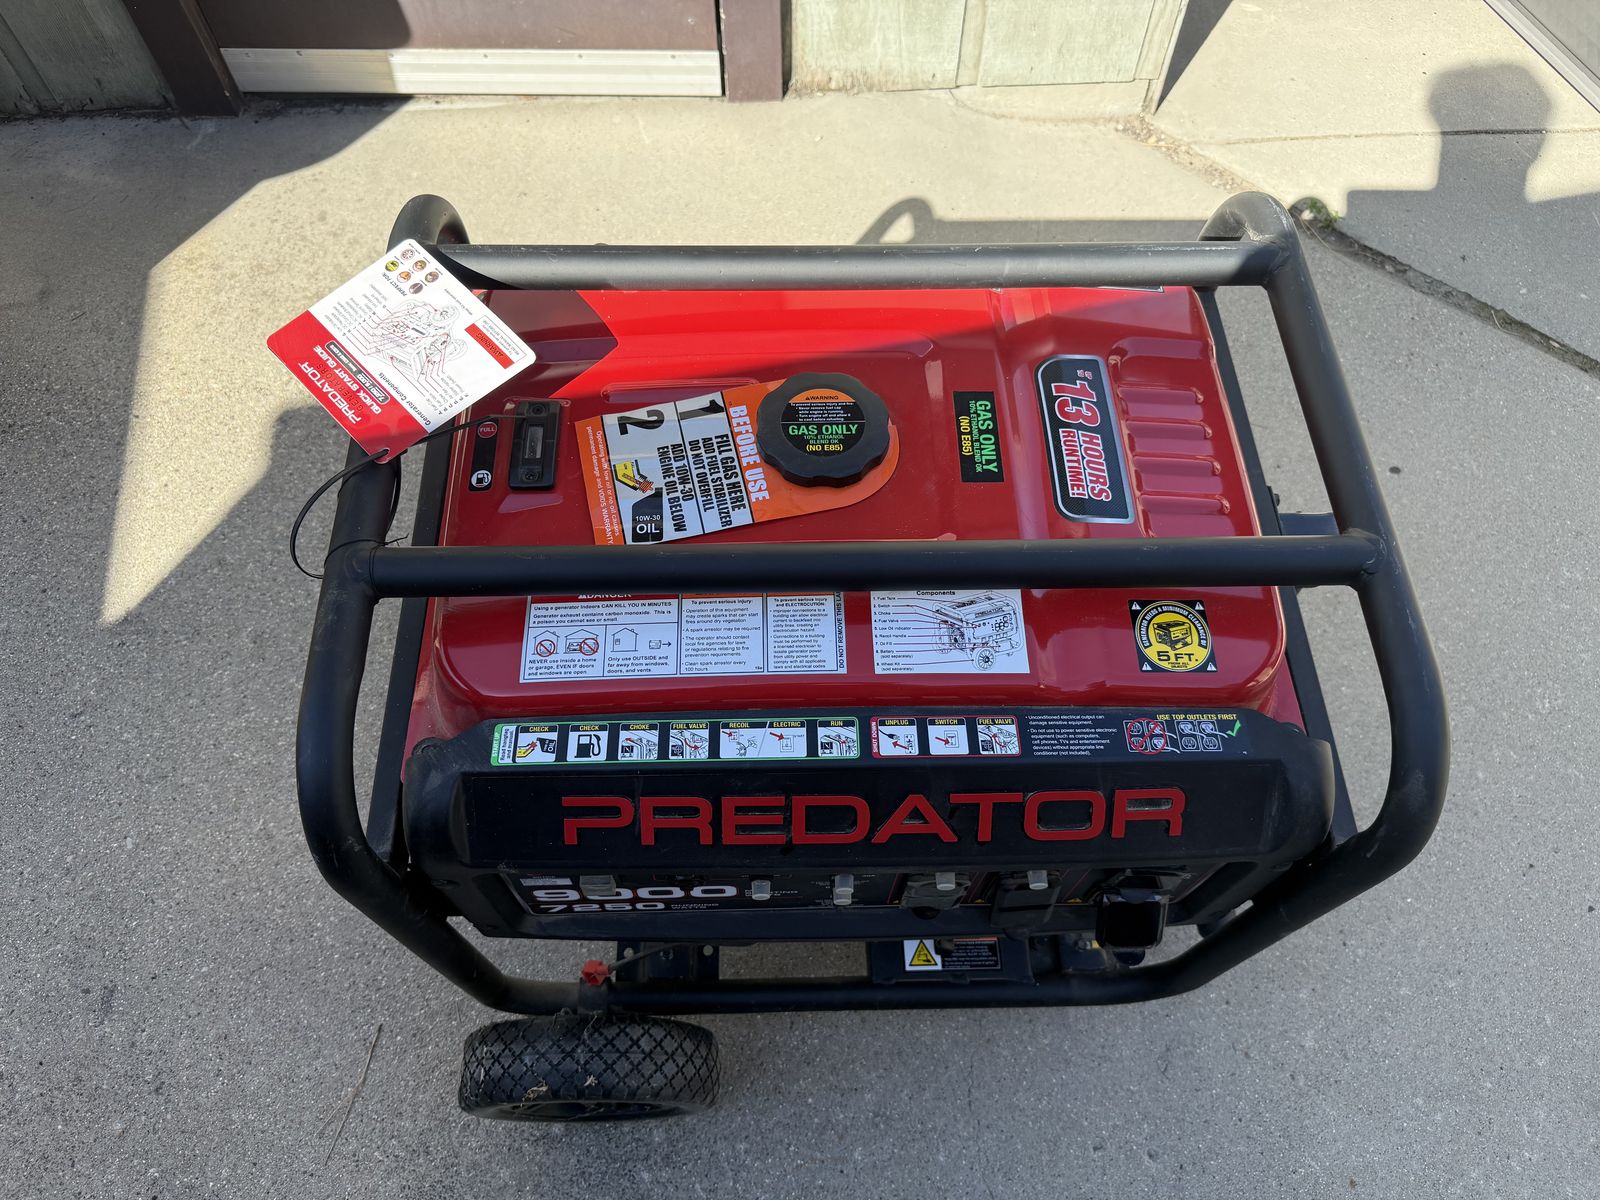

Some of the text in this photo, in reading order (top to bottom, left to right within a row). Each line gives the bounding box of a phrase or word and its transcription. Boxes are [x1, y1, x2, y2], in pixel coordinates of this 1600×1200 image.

[389, 279, 407, 296] PERFECT
[312, 344, 337, 367] GUIDE
[315, 362, 364, 411] GENERATORS
[334, 366, 359, 390] START
[298, 361, 362, 423] PREDATOR
[356, 389, 382, 414] QUICK
[376, 371, 432, 426] Generator Components
[1051, 380, 1101, 427] 13
[617, 409, 664, 436] 2
[679, 399, 725, 421] 1
[586, 424, 596, 454] permanent
[789, 424, 858, 435] GAS ONLY
[958, 416, 974, 456] (NO E85)
[969, 400, 983, 473] 10% ETHANOL BLEND OK
[976, 400, 998, 473] GAS ONLY
[730, 405, 770, 503] BEFORE USE
[806, 443, 844, 452] (NO E85)
[590, 454, 600, 477] damage
[670, 443, 695, 502] ADD 10W-30
[688, 440, 715, 513] DO NOT OVERFILL
[714, 434, 747, 512] FILL GAS HERE
[1059, 428, 1088, 499] RUNTIME!
[1078, 430, 1112, 502] HOURS
[594, 430, 606, 457] Operating
[601, 457, 609, 469] with
[608, 495, 614, 504] no
[611, 514, 620, 535] causes
[657, 445, 688, 533] ENGINE OIL BELOW
[701, 437, 733, 528] ADD FUEL STABILIZER
[597, 488, 606, 506] VOIDS
[635, 514, 660, 522] 10W-30
[636, 523, 660, 534] OIL
[1144, 608, 1158, 620] NEEDS
[1162, 605, 1189, 616] MINIMUM
[1140, 619, 1150, 647] GENERATOR
[1188, 613, 1206, 639] CLEARANCE
[838, 658, 845, 669] DO
[1156, 651, 1199, 662] 5 FT.
[492, 739, 500, 757] START
[562, 786, 1184, 845] PREDATOR
[540, 902, 666, 913] 7250
